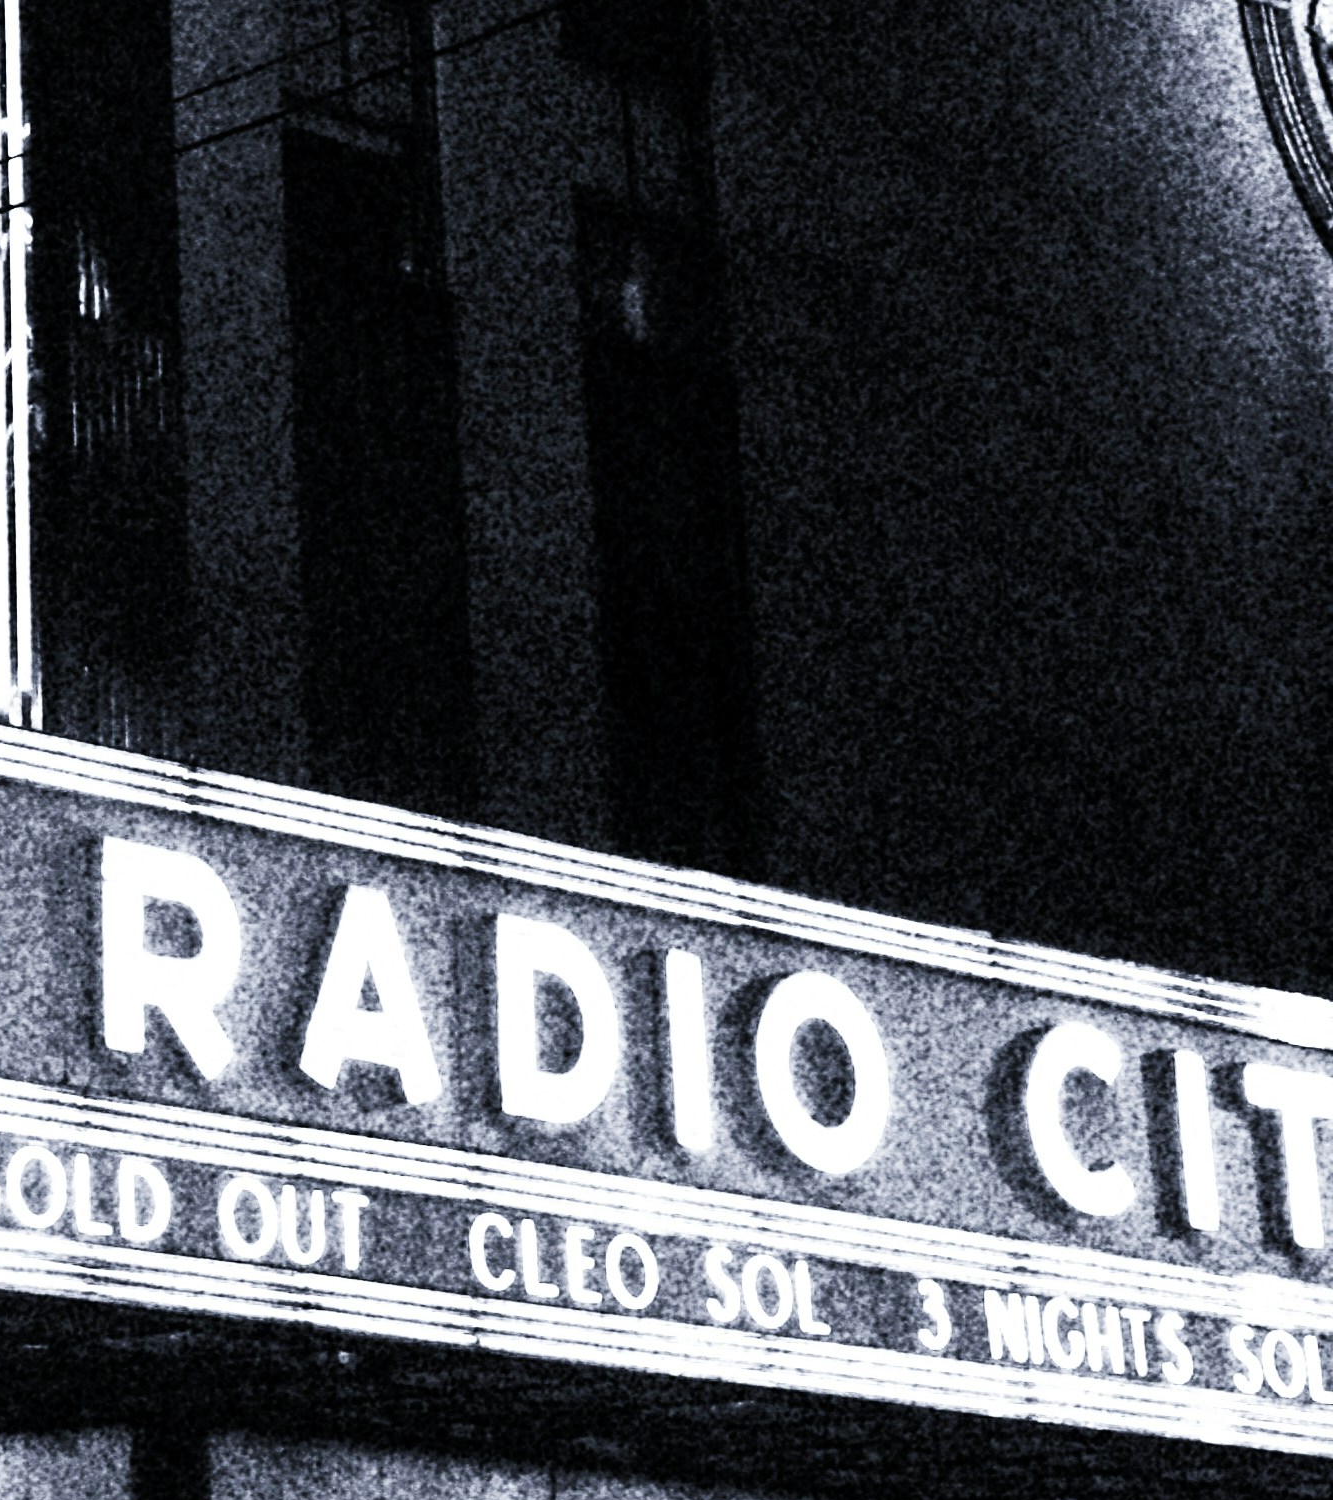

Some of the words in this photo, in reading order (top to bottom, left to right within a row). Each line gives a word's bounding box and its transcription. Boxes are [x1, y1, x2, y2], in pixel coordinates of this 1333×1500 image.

[100, 837, 891, 1174] RADIO
[217, 1173, 368, 1270] OUT
[469, 1212, 658, 1310] CLEO
[704, 1245, 831, 1338] SOL
[917, 1278, 953, 1351] 3
[983, 1288, 1194, 1385] NIGHTS
